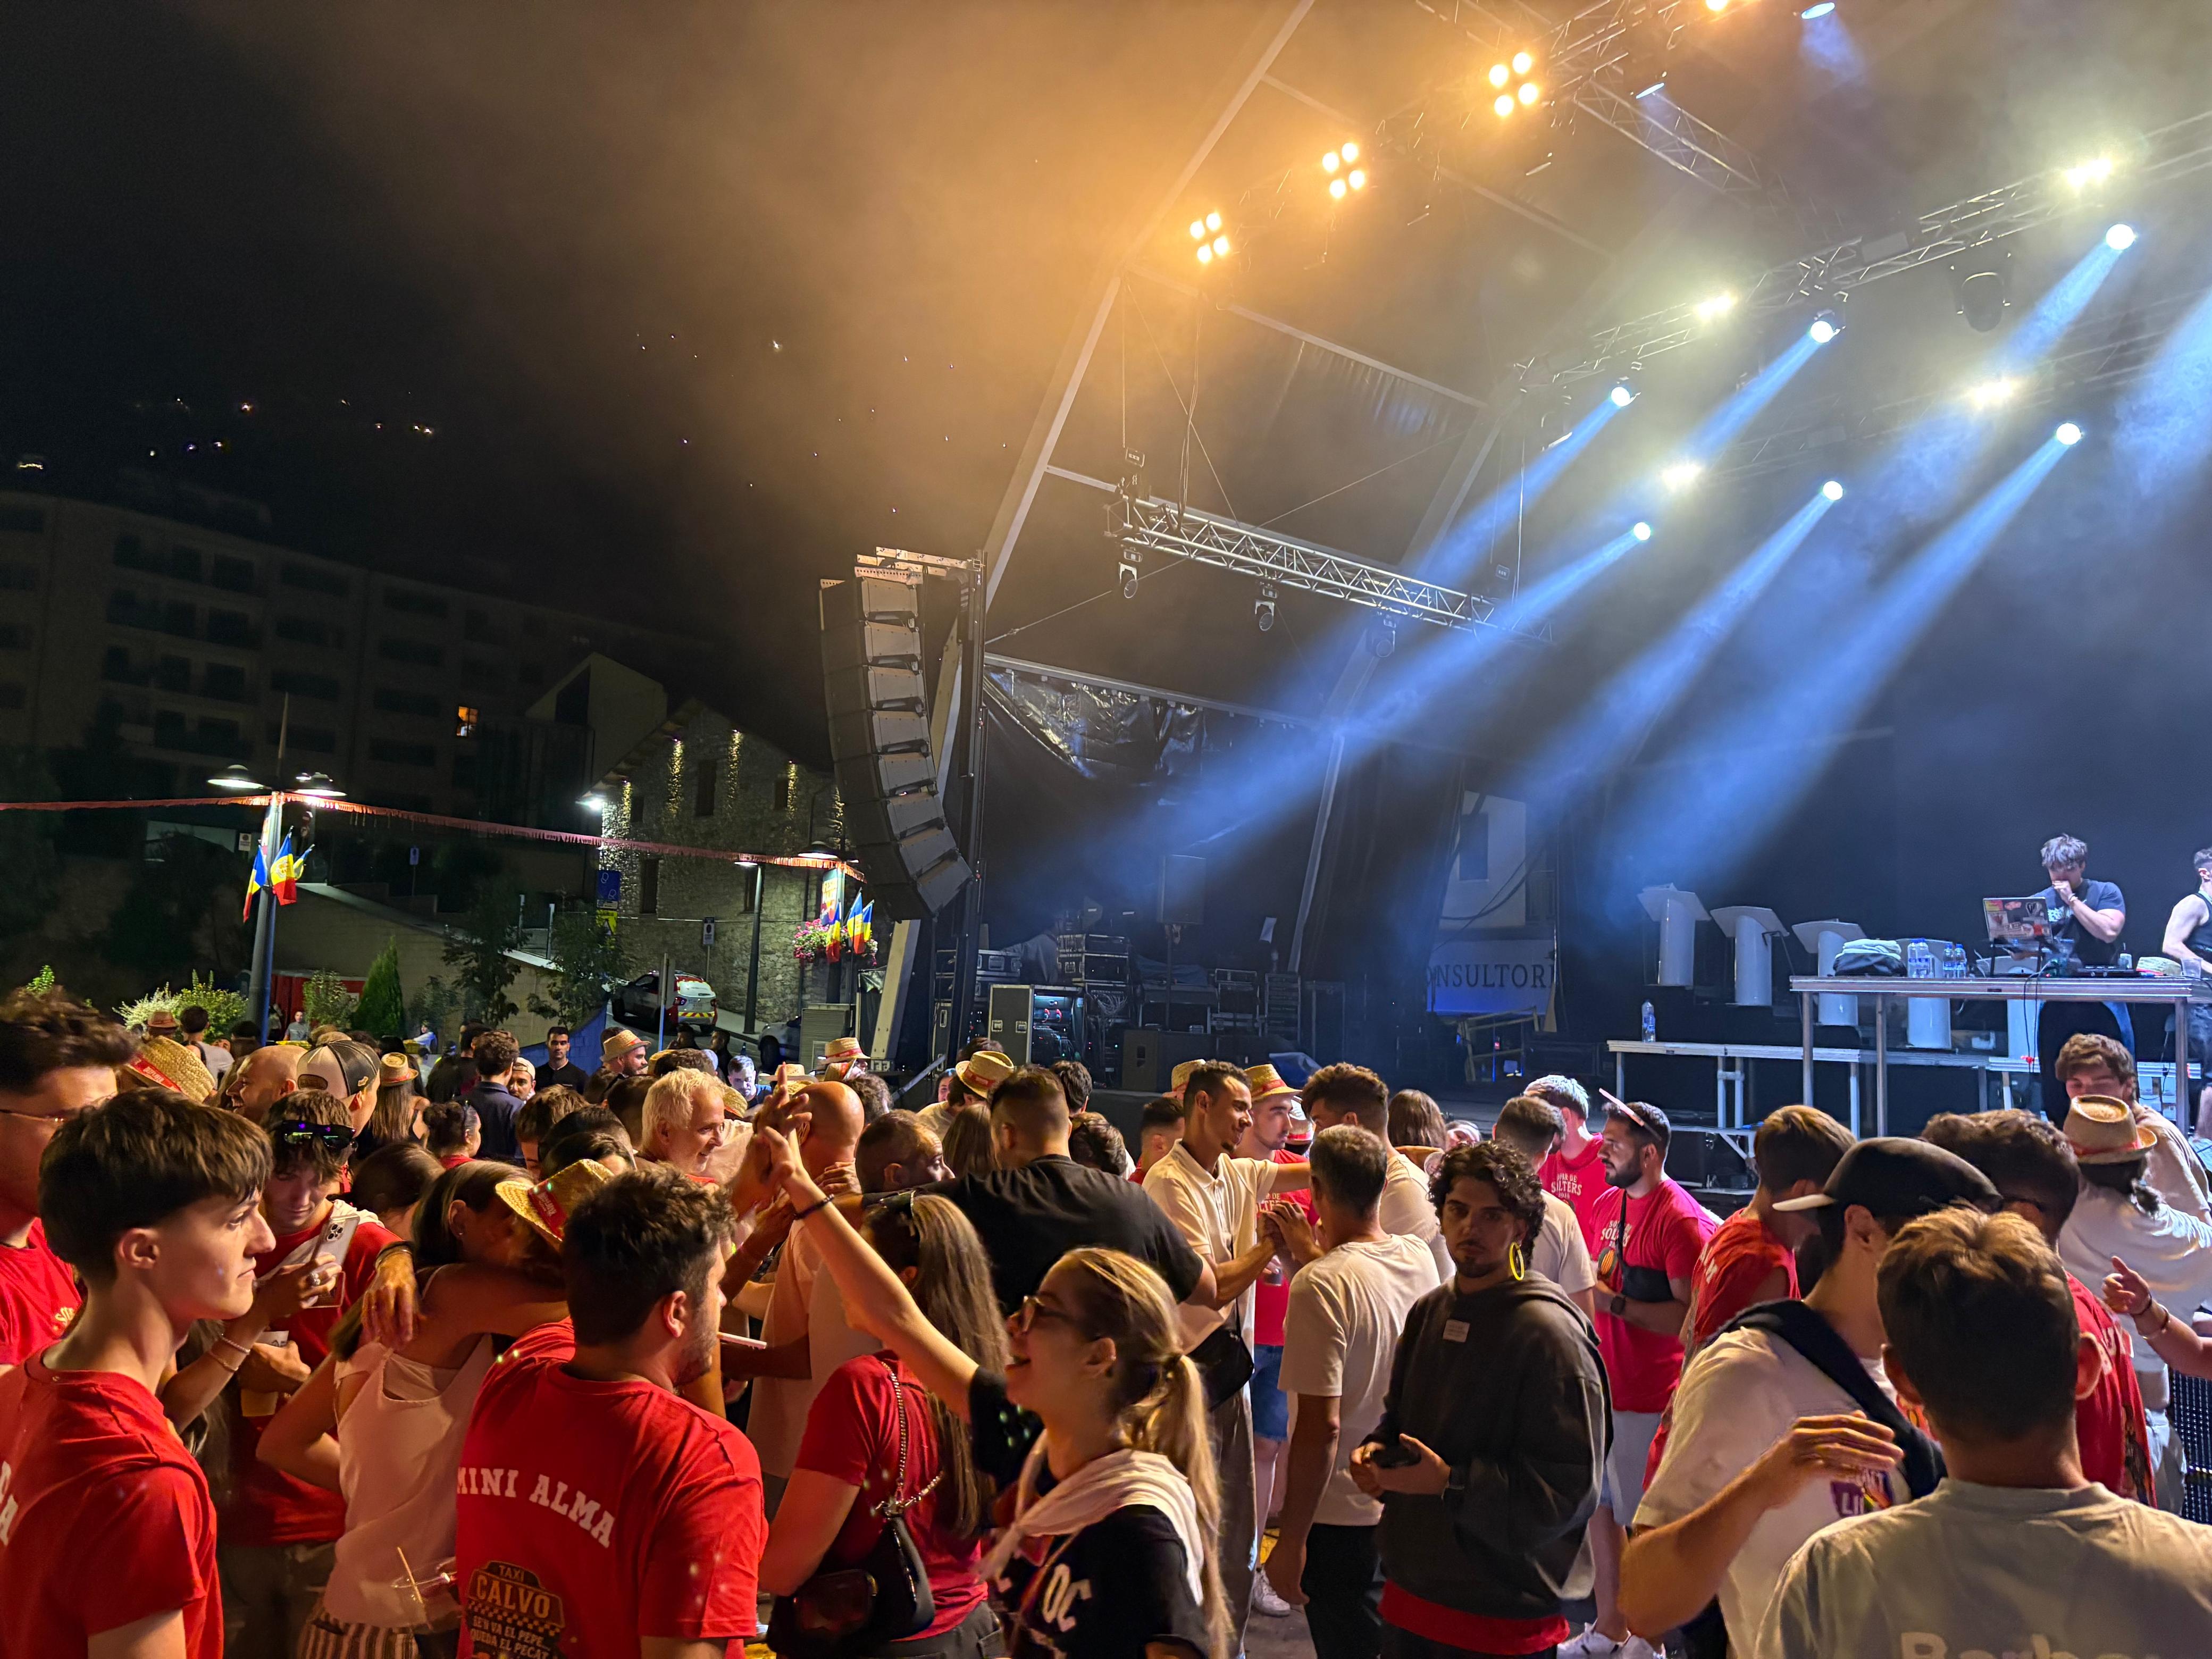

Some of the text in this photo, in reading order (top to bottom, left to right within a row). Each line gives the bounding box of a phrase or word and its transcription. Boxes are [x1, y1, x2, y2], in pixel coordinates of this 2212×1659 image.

[529, 1473, 615, 1548] ALMA
[499, 1565, 525, 1582] TAXI
[476, 1574, 550, 1619] CALVO
[470, 1628, 498, 1647] QUEDA
[499, 1638, 512, 1651] EL
[491, 1622, 502, 1635] VA
[504, 1626, 516, 1639] EL
